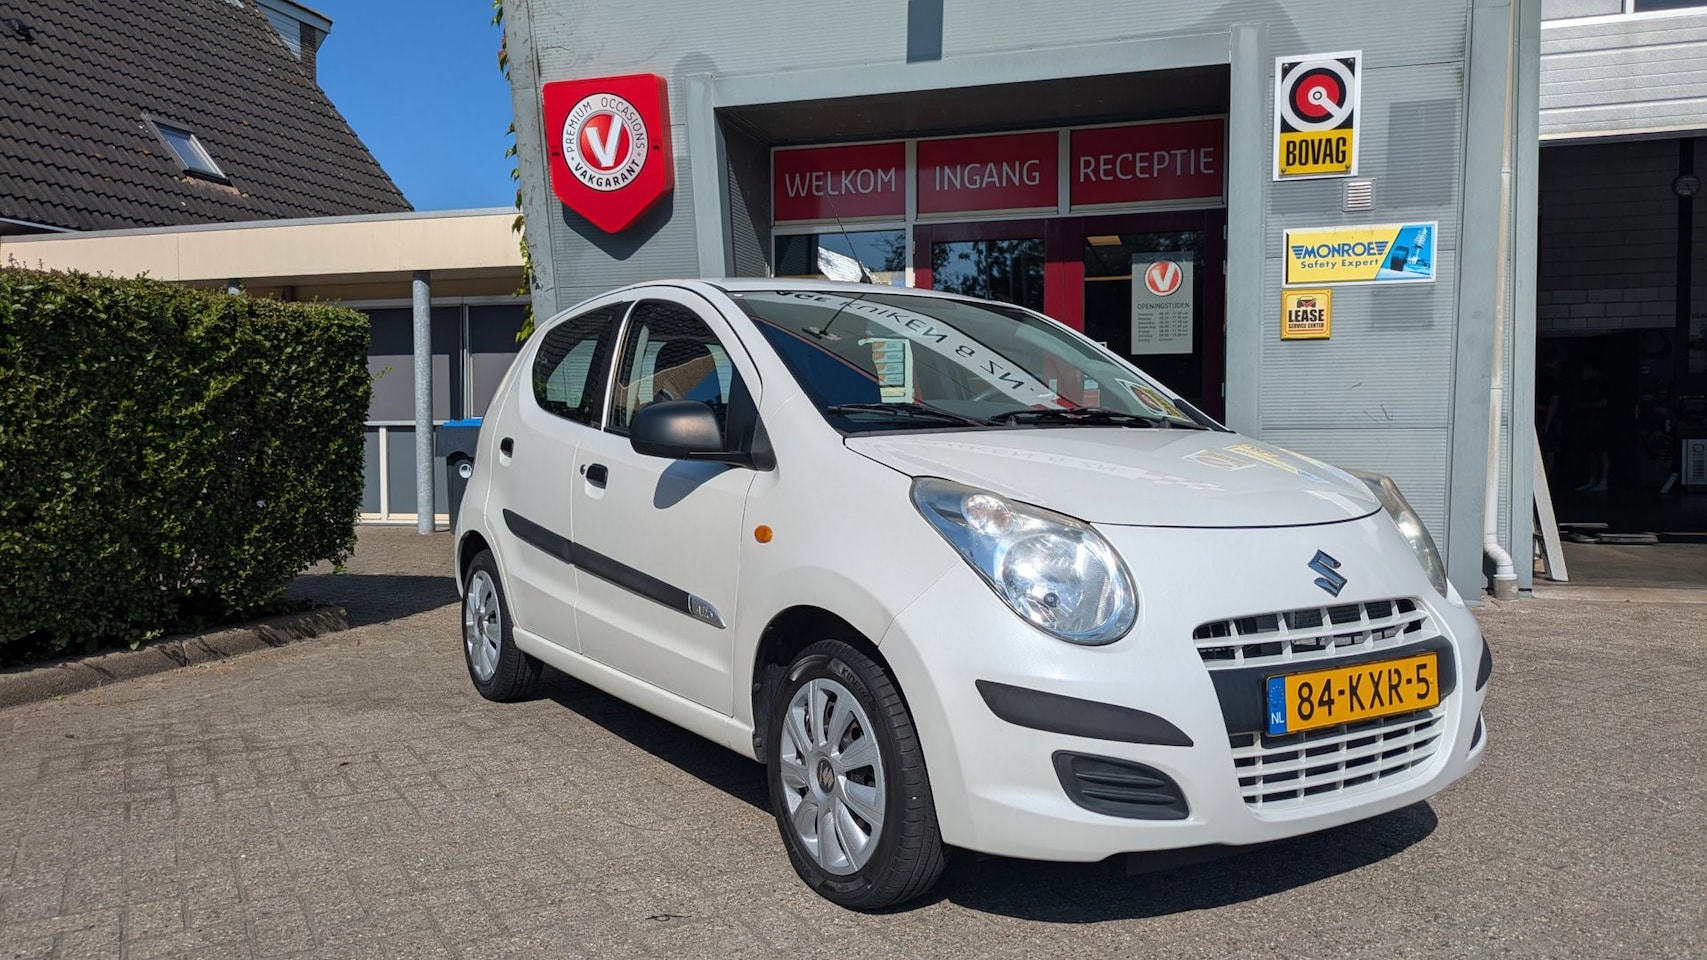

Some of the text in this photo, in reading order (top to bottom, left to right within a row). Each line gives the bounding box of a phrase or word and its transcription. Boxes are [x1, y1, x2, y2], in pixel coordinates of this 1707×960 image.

[566, 97, 646, 153] PREMIUM OCCASIONS
[1079, 147, 1215, 183] RECEPTIE
[1285, 136, 1347, 167] BOVAG
[574, 159, 640, 188] VAKGARANT
[784, 167, 896, 198] WELKOM
[935, 160, 1041, 191] INGANG
[1300, 258, 1379, 270] Safety Expert
[1302, 241, 1375, 259] MONROE
[1137, 301, 1190, 310] OPENINGSTIJDEN
[1288, 309, 1325, 322] LEASE
[1297, 663, 1430, 721] 84-KXR-5
[1271, 711, 1285, 725] NL
